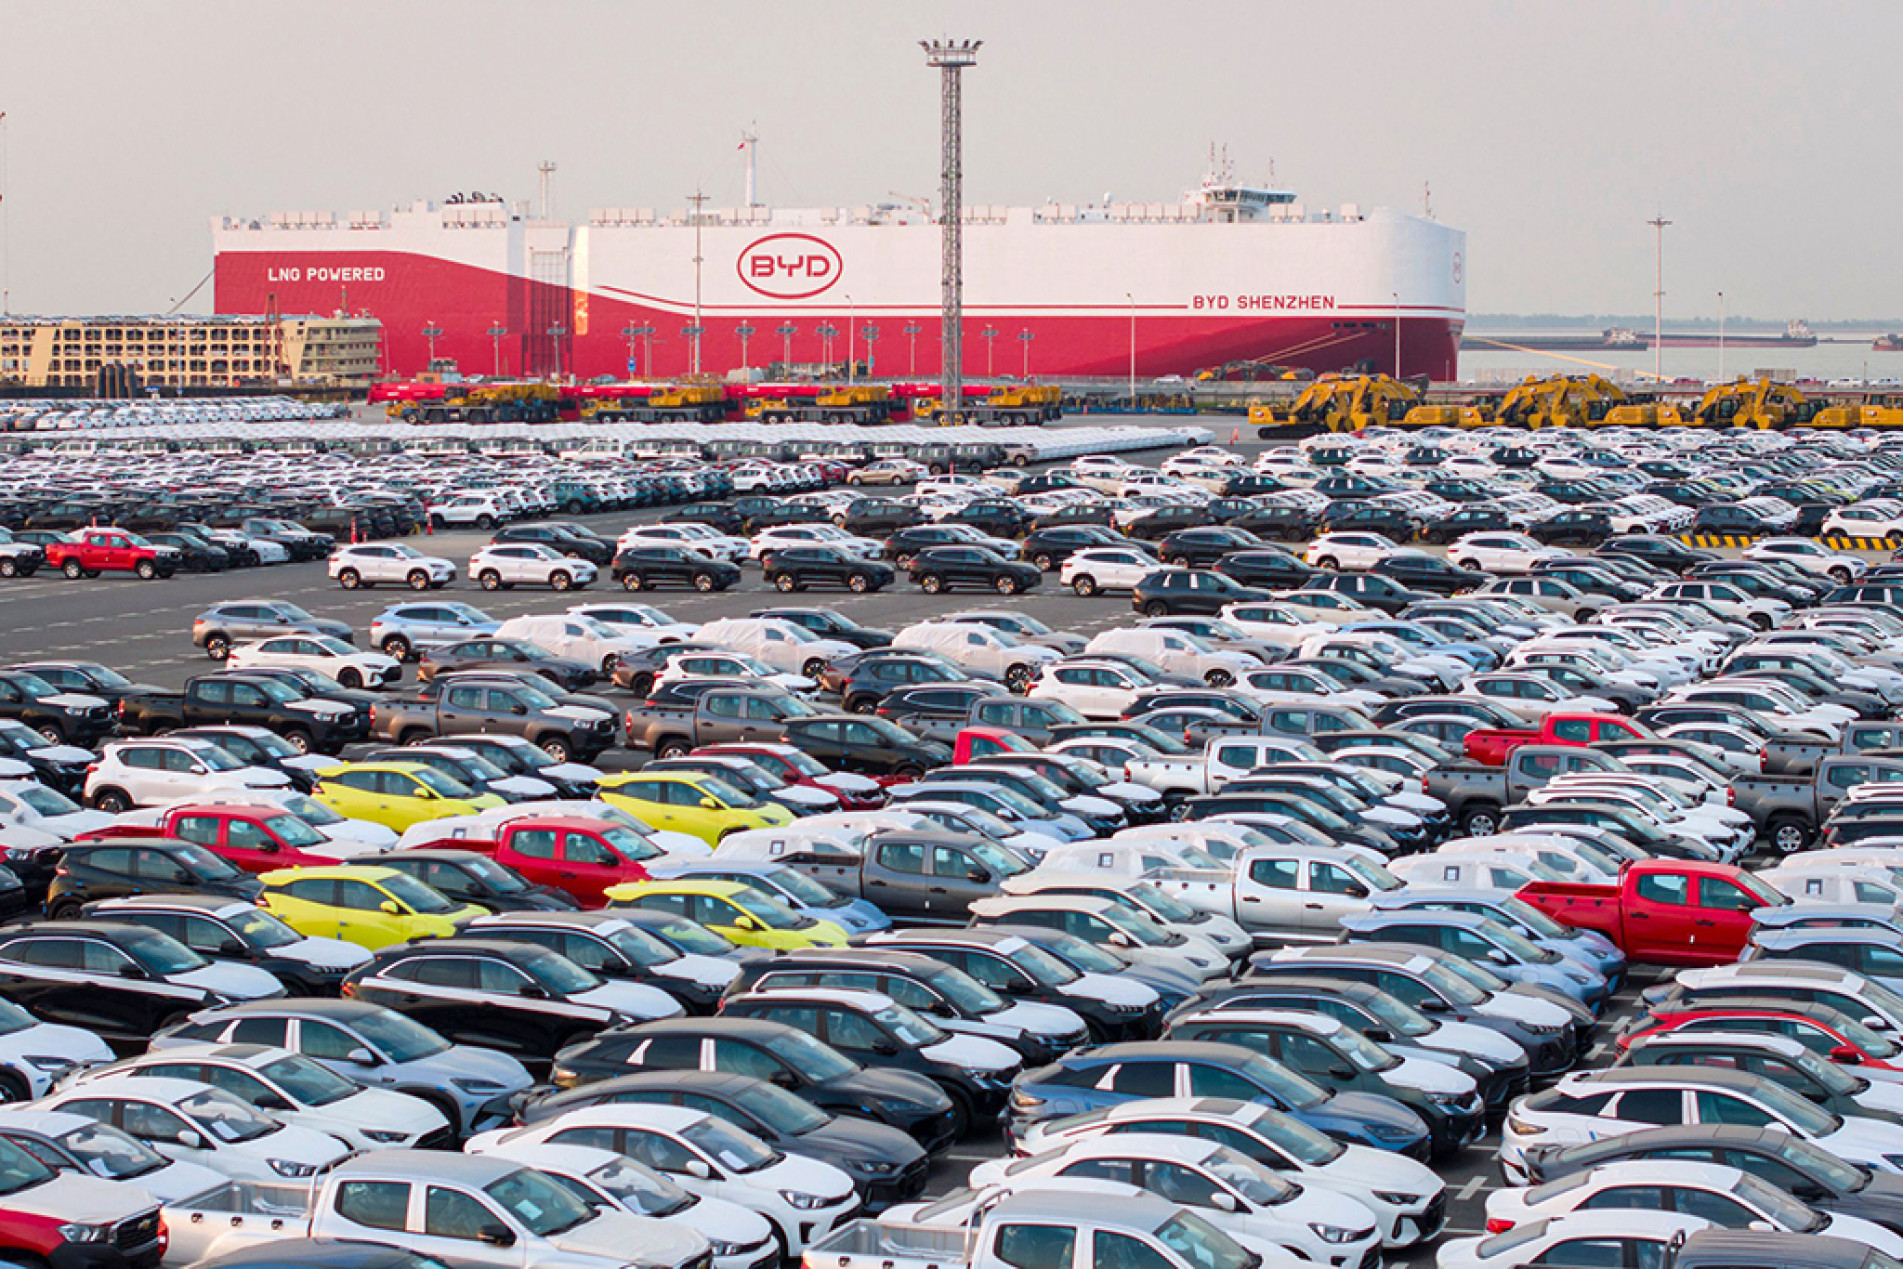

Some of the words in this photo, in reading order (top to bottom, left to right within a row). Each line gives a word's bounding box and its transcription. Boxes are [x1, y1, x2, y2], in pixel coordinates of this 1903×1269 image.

[751, 255, 830, 277] BYD
[268, 267, 300, 281] LNG
[306, 267, 385, 281] POWERED
[1193, 295, 1229, 309] BYD
[1237, 295, 1334, 309] SHENZHEN
